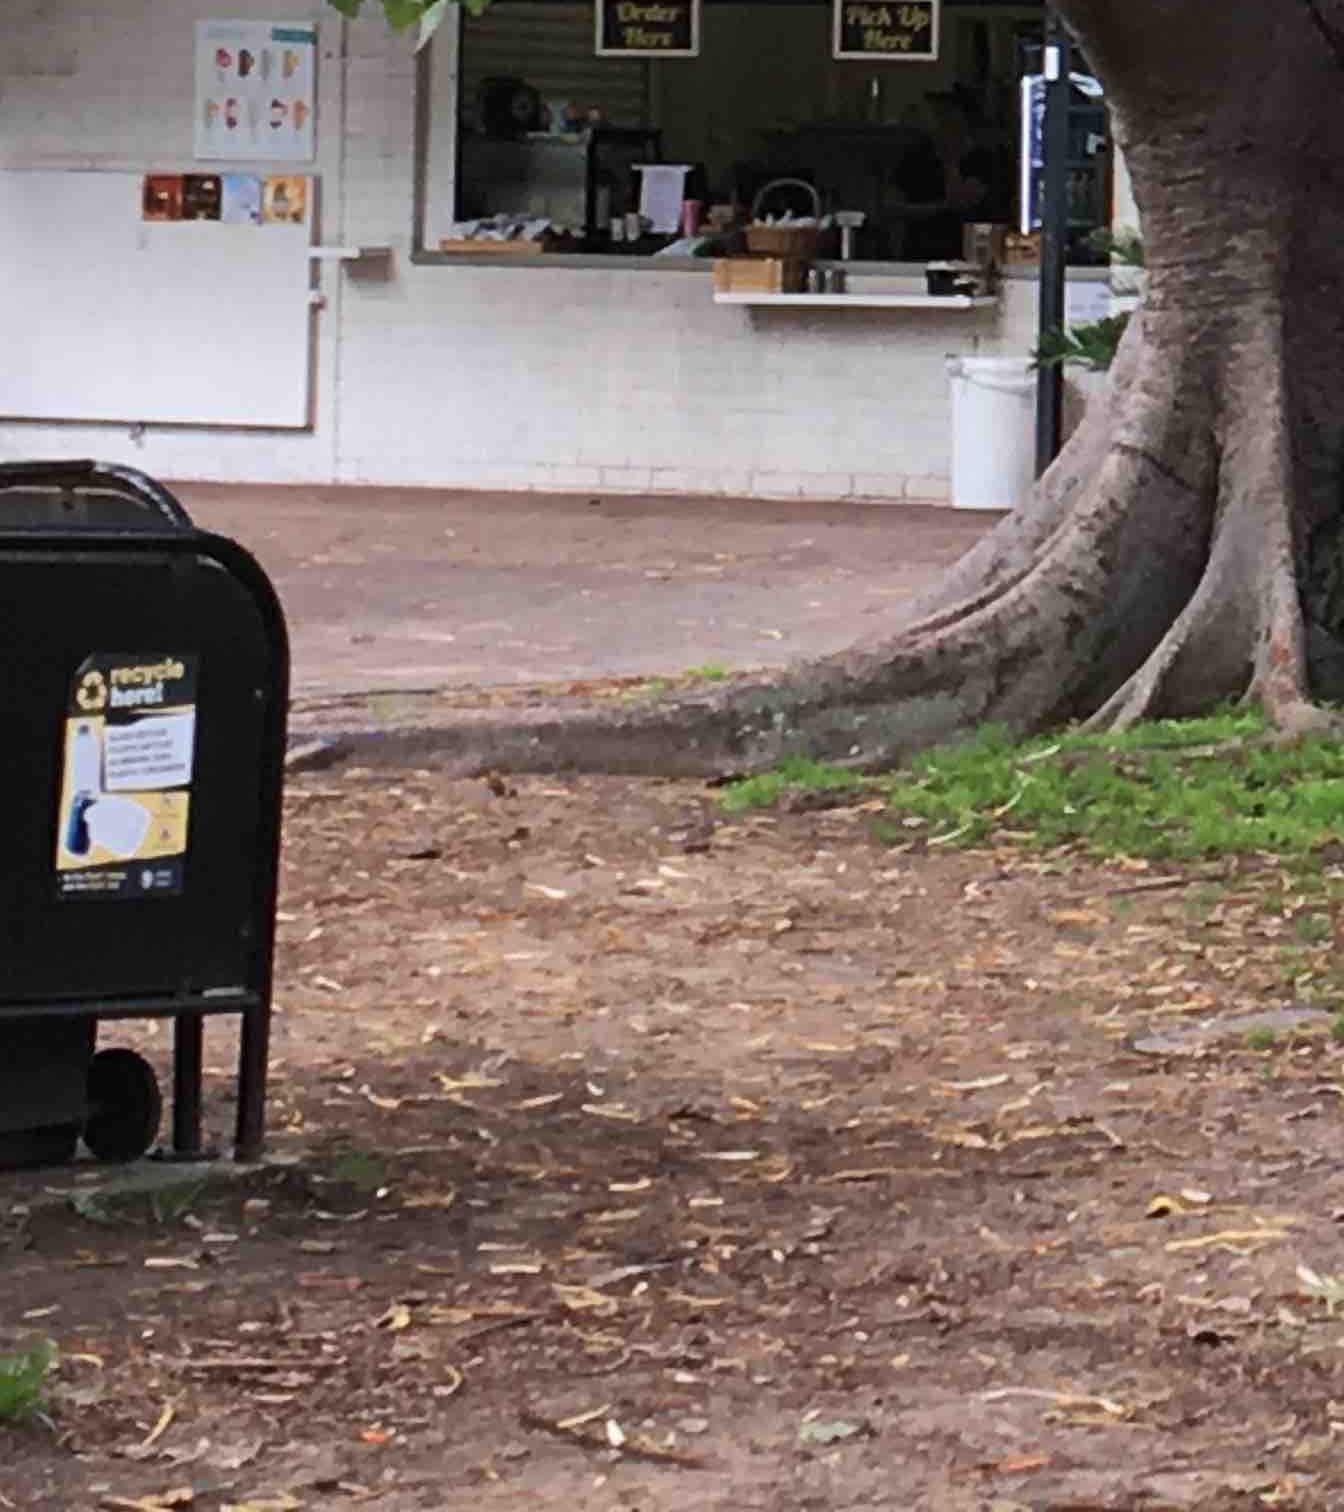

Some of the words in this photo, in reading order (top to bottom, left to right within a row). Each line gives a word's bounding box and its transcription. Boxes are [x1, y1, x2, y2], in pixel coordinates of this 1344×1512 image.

[616, 2, 679, 22] Order
[847, 5, 892, 26] Pick
[898, 5, 929, 32] Up
[624, 27, 673, 47] Here
[864, 28, 913, 50] Here
[111, 657, 184, 686] recycle
[111, 681, 163, 707] here!
